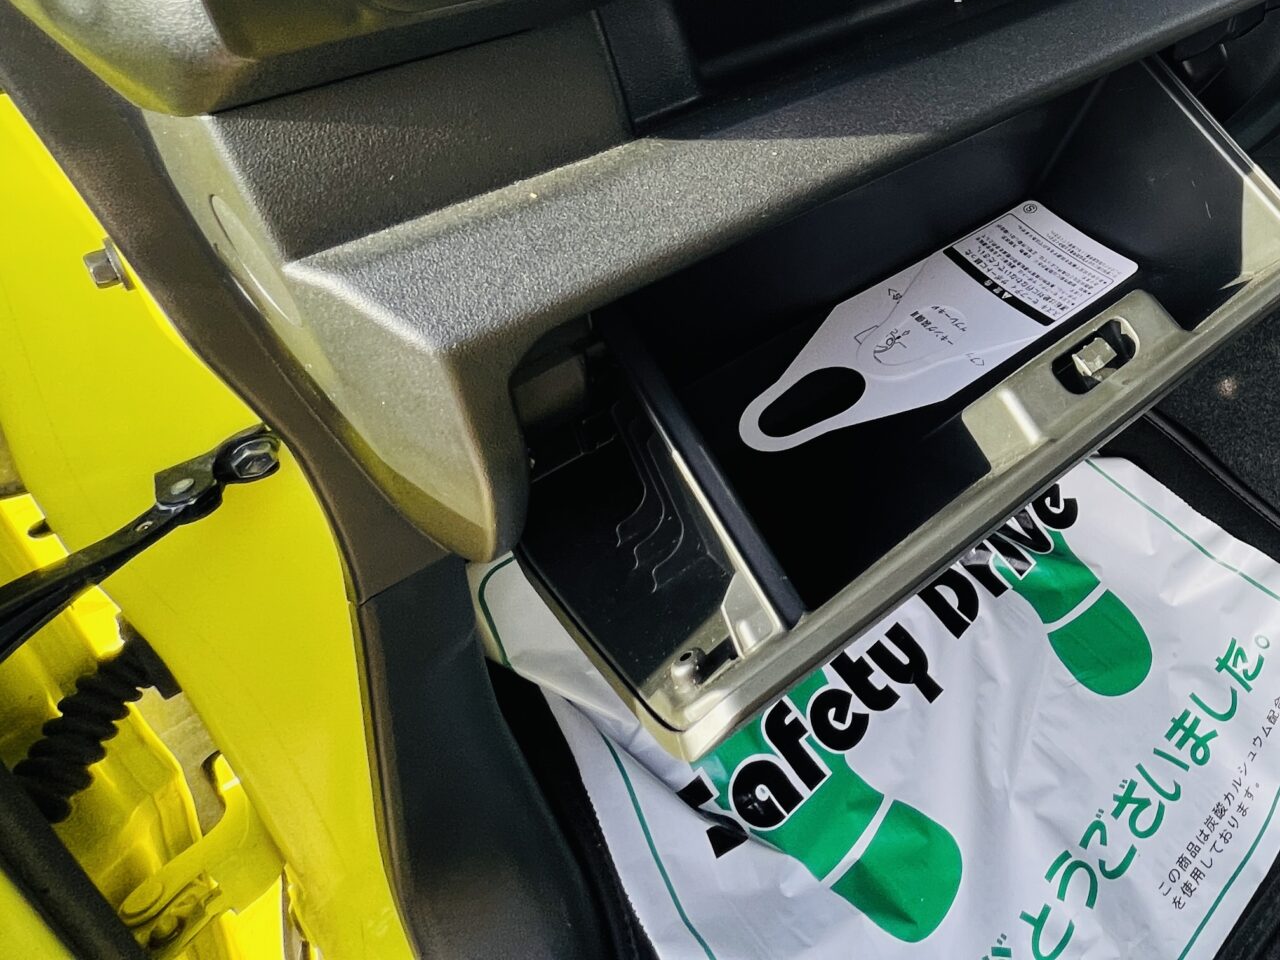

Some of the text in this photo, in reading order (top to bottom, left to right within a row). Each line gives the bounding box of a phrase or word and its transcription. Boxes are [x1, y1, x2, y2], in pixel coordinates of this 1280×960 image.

[676, 484, 1079, 859] Safety Drive
[1172, 782, 1260, 910] を使用しております。
